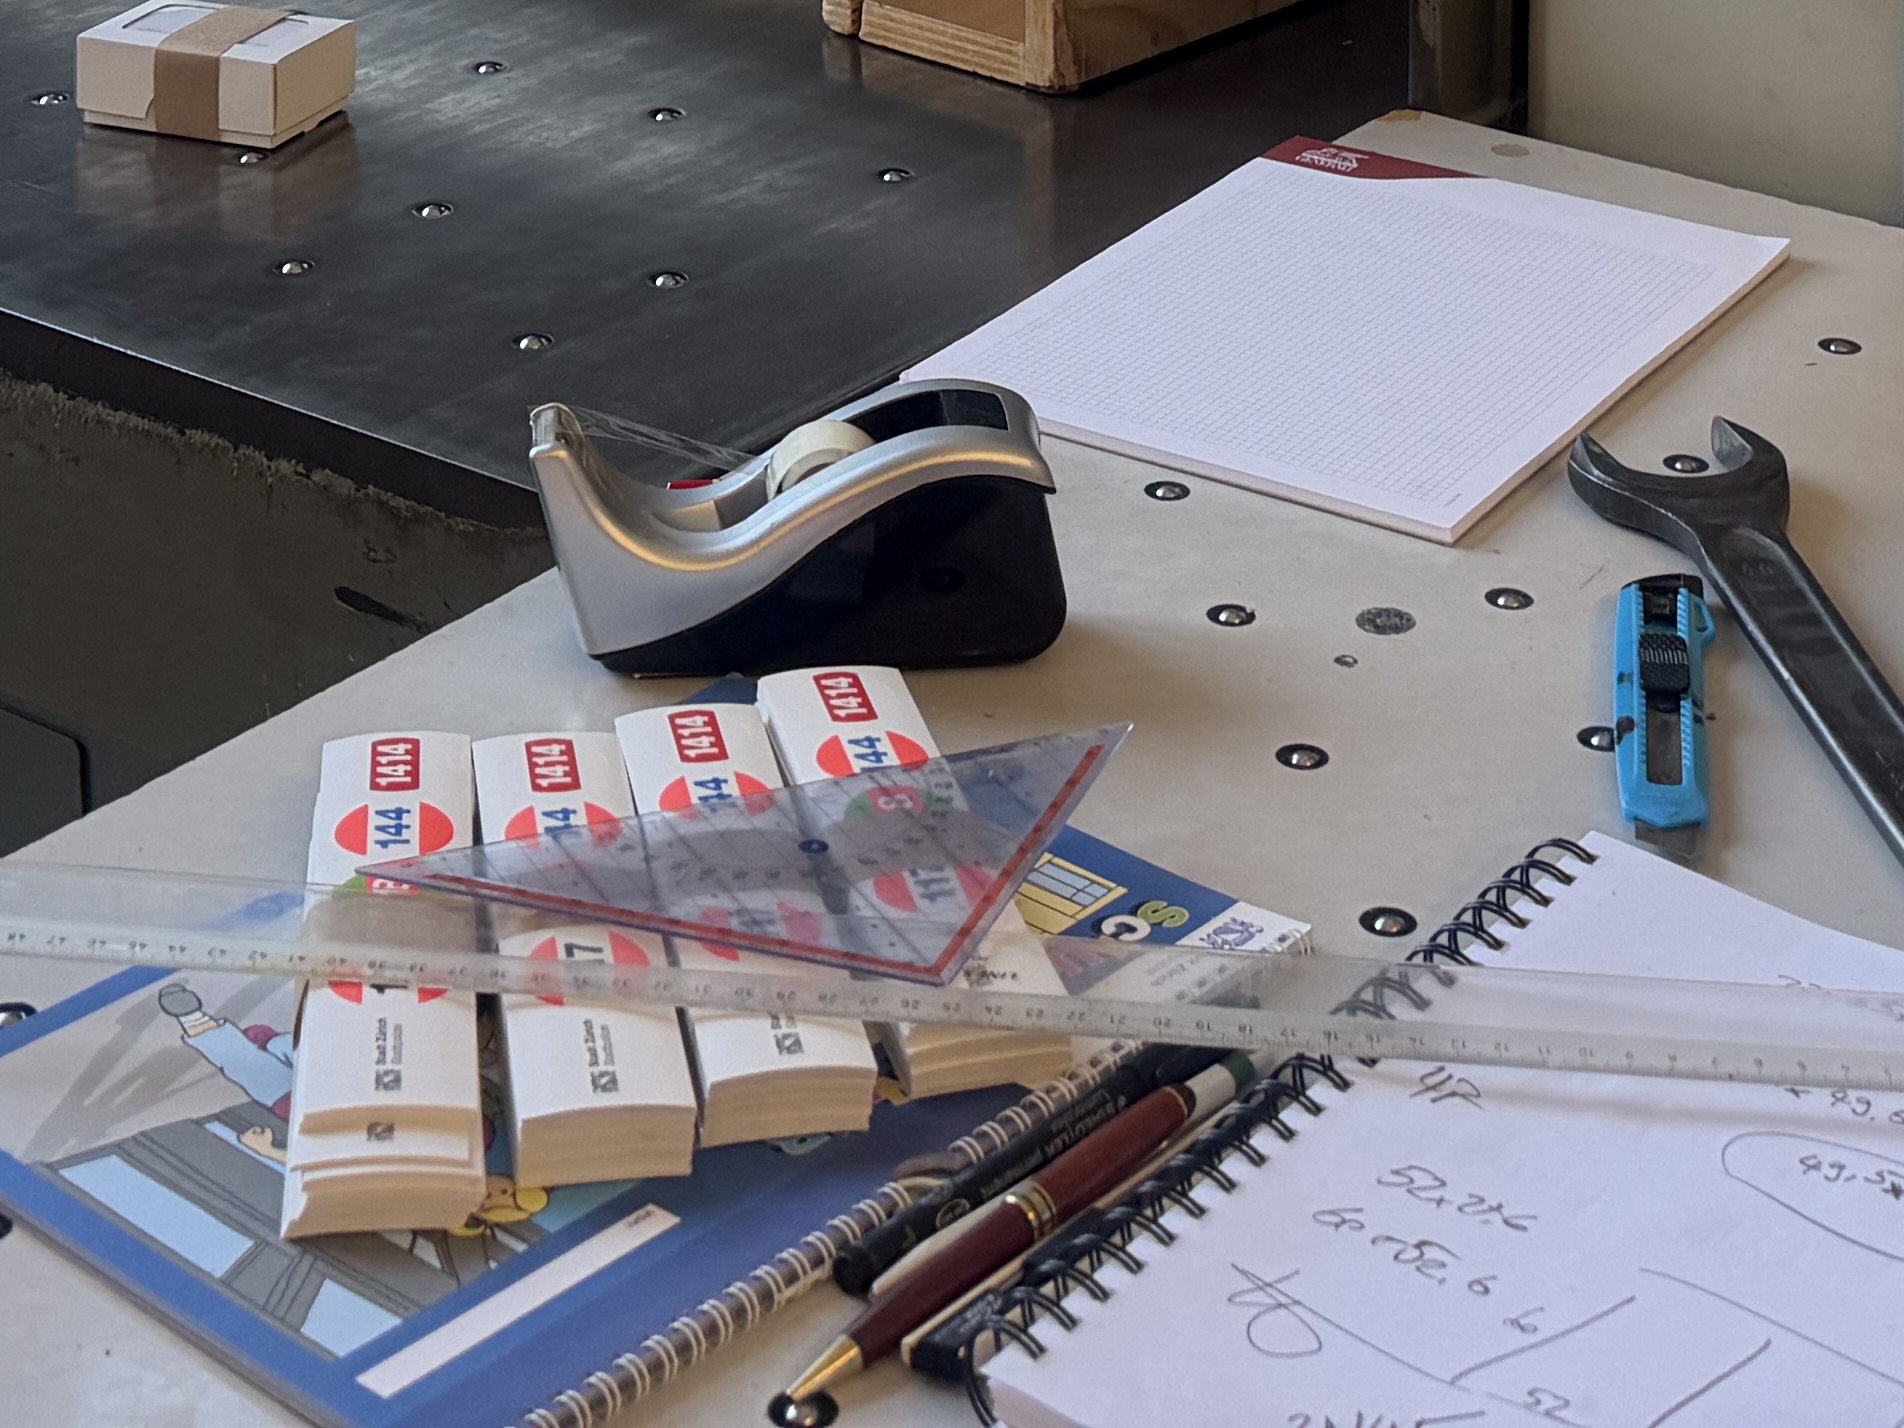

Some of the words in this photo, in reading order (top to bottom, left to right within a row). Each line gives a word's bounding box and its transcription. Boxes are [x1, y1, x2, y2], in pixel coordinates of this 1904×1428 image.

[812, 676, 867, 718] 1414
[674, 714, 720, 758] 1414
[375, 743, 413, 787] 1414
[530, 744, 572, 788] 1414
[373, 806, 411, 848] 144
